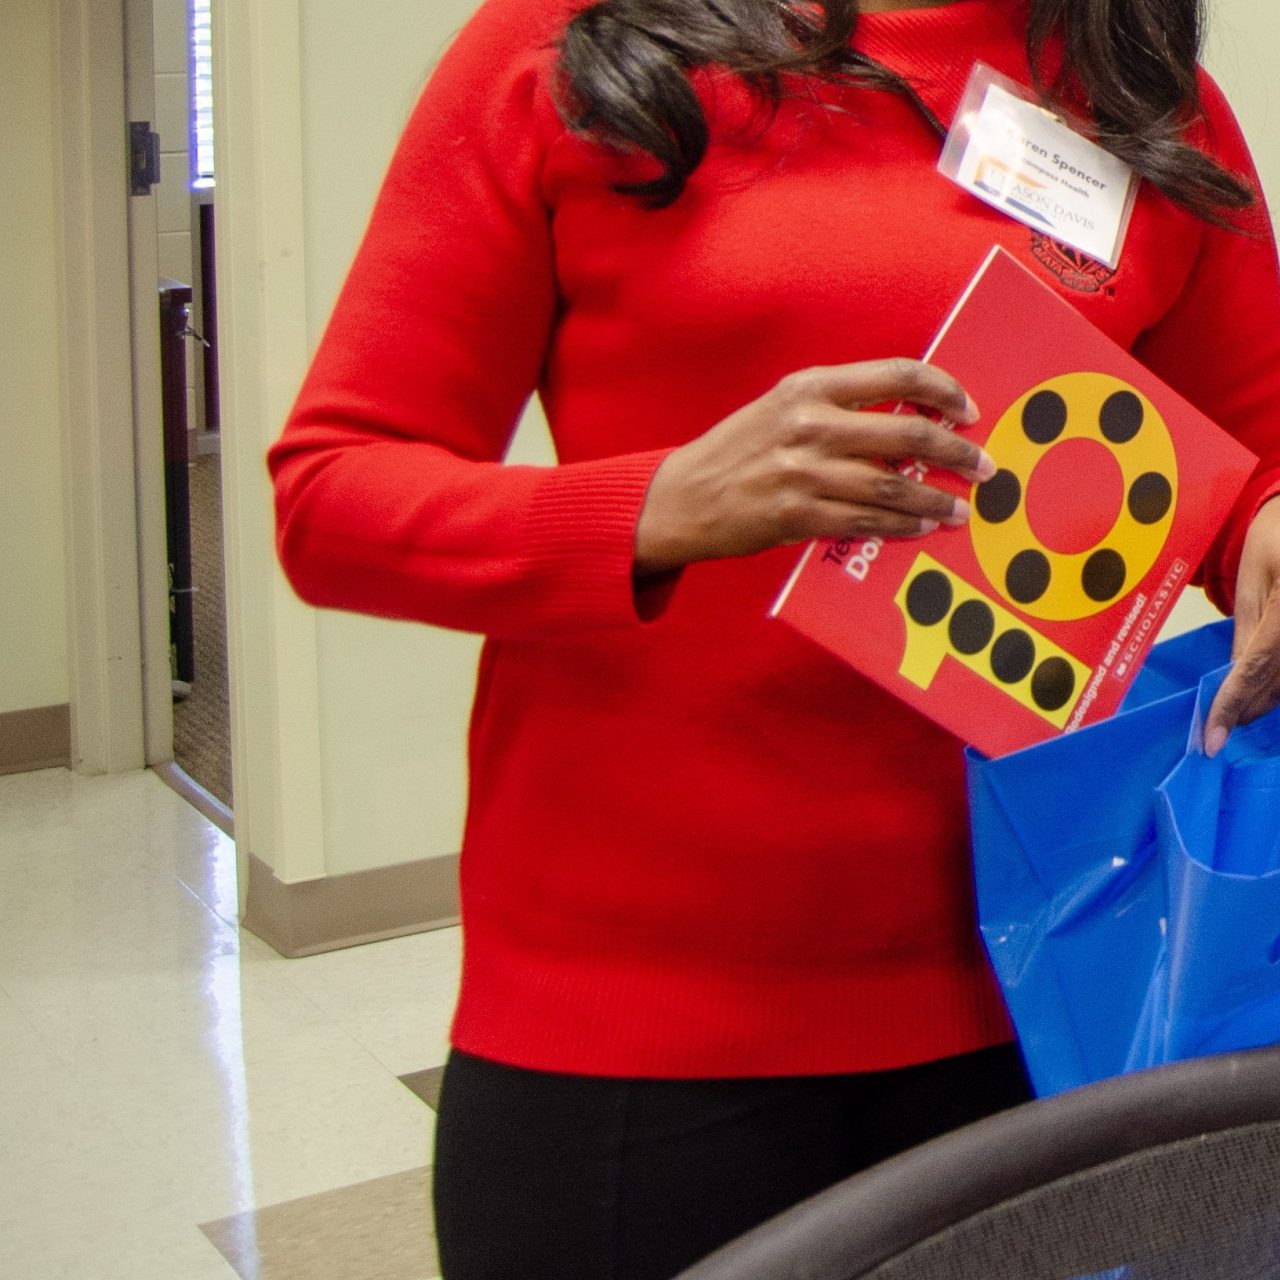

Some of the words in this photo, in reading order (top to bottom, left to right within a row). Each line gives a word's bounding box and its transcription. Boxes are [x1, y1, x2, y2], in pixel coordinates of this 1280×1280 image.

[1051, 153, 1107, 190] Spencer
[1010, 182, 1050, 210] ASON
[1053, 203, 1096, 231] DAVIS
[1103, 639, 1121, 668] and
[1117, 592, 1148, 642] revised!
[1124, 562, 1185, 662] SCHOLASTIC
